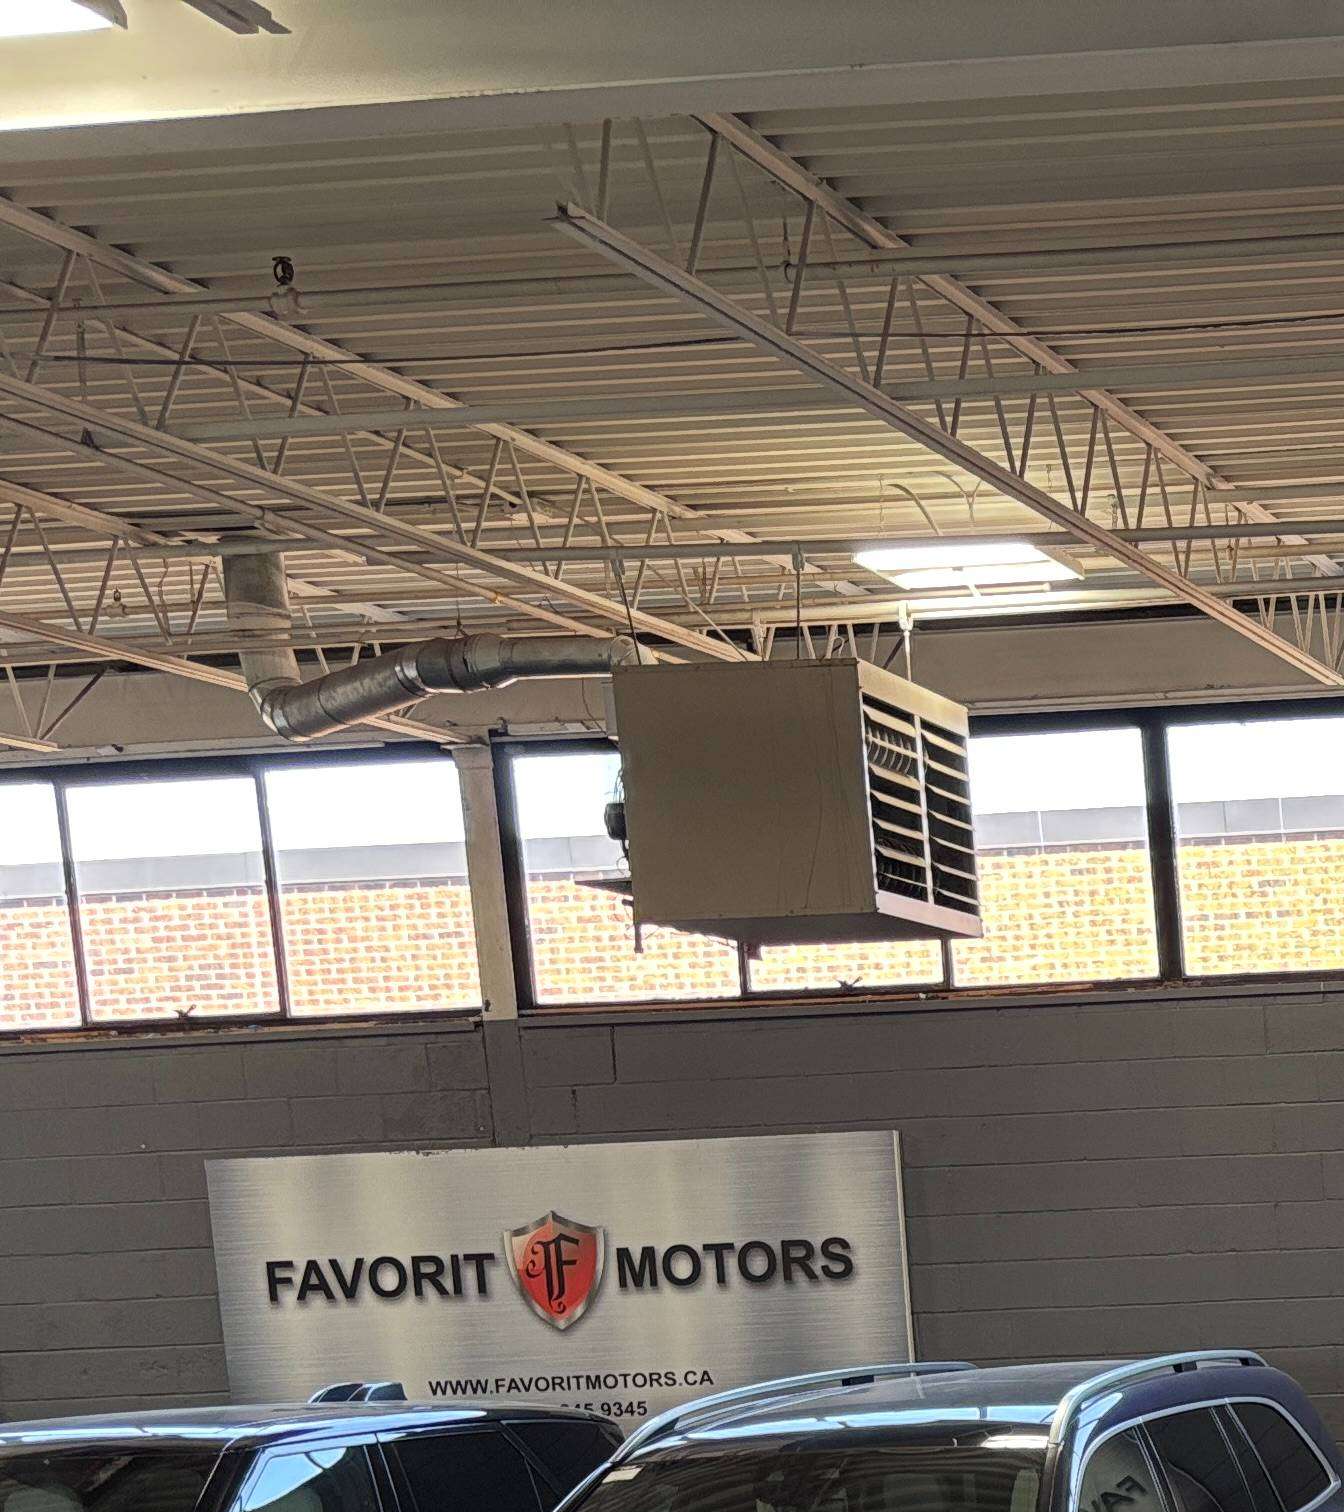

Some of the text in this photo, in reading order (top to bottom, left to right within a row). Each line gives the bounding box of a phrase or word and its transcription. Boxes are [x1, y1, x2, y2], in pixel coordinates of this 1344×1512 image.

[265, 1253, 495, 1304] FAVORIT
[616, 1237, 854, 1288] MOTORS
[428, 1370, 714, 1396] WWW.FAVORITMOTORS.CA
